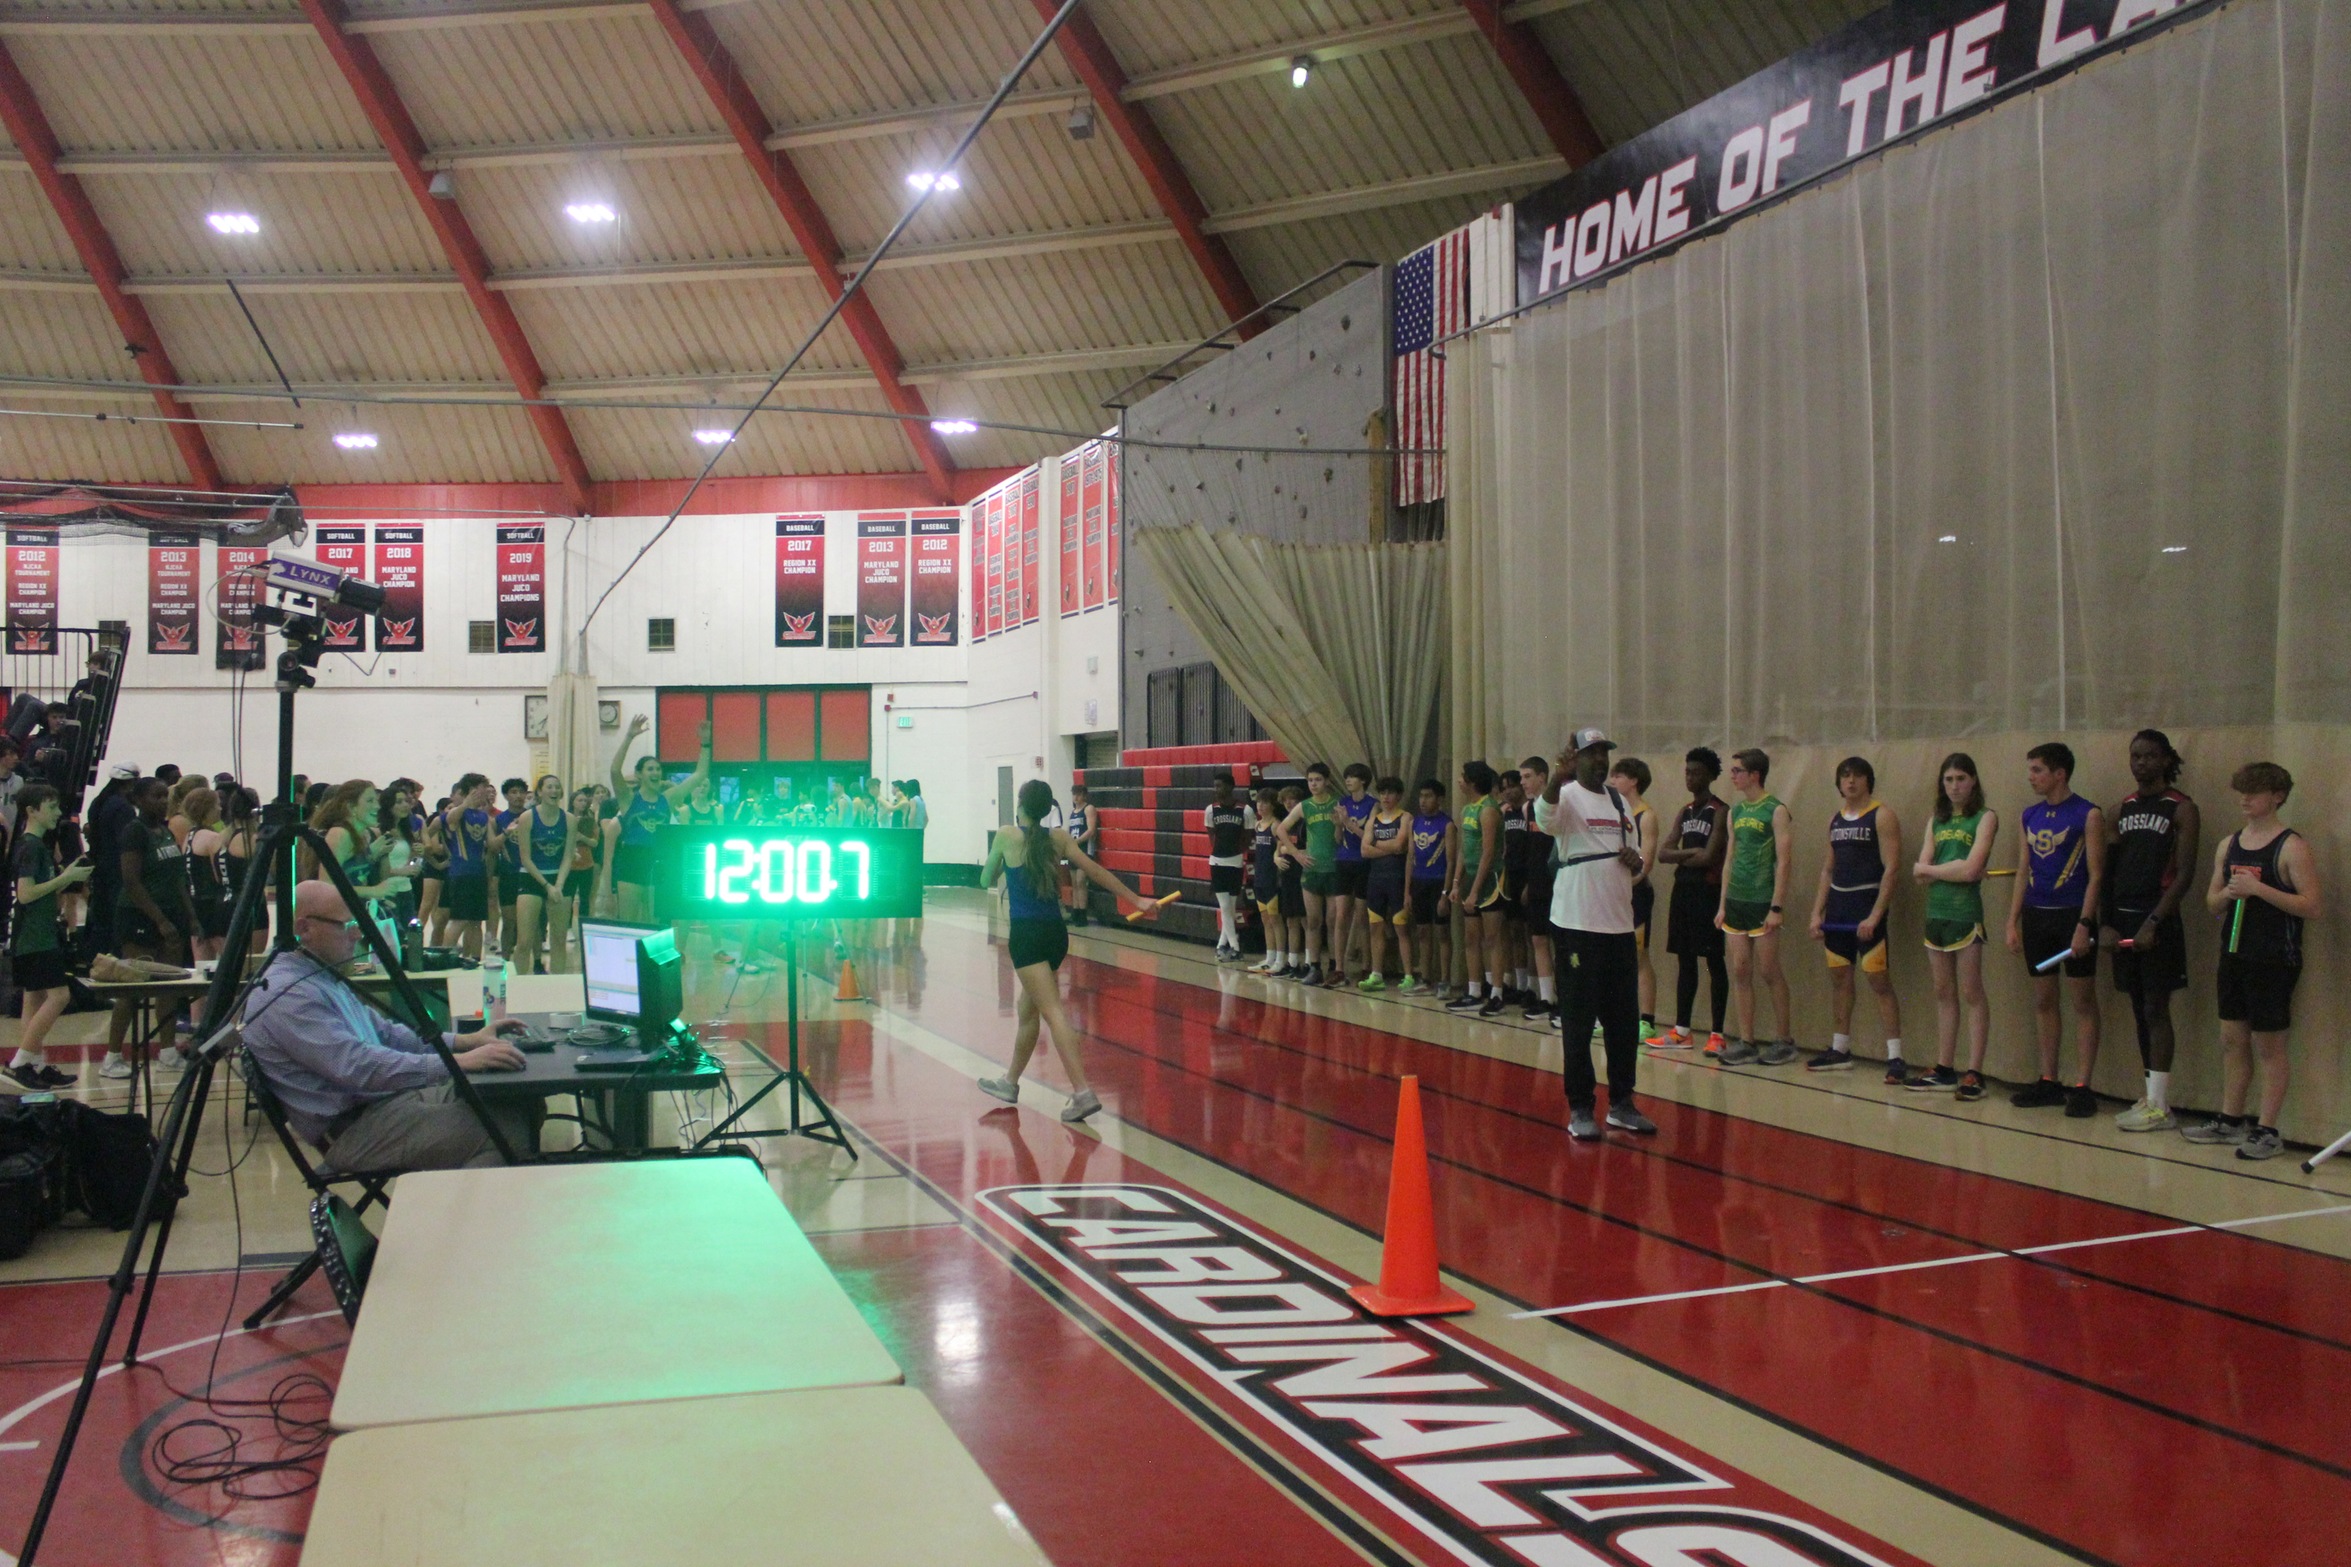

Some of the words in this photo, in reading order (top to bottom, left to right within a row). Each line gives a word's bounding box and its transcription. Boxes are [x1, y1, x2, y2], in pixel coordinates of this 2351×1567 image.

[1538, 153, 1698, 295] HOME
[1716, 99, 1811, 213] OF
[1838, 7, 2005, 159] THE
[507, 532, 534, 540] SOFTBALL
[788, 540, 812, 551] 2017
[869, 541, 894, 553] 2013
[922, 539, 948, 550] 2012
[18, 551, 46, 562] 2012
[161, 552, 187, 562] 2013
[229, 552, 255, 562] 2014
[328, 548, 353, 559] 2017
[387, 548, 412, 558] 2018
[510, 553, 532, 563] 2019
[807, 559, 816, 567] XX
[864, 561, 899, 569] MARYLAND
[290, 565, 331, 585] LYNX
[382, 566, 417, 574] MARYLAND
[502, 574, 540, 582] MARYLAND
[512, 584, 531, 592] JUCO
[500, 594, 540, 602] CHAMPIONS
[2118, 813, 2170, 835] CROSSLAND
[1420, 832, 1428, 845] S
[2037, 829, 2053, 850] S
[704, 838, 870, 904] 12:00.7
